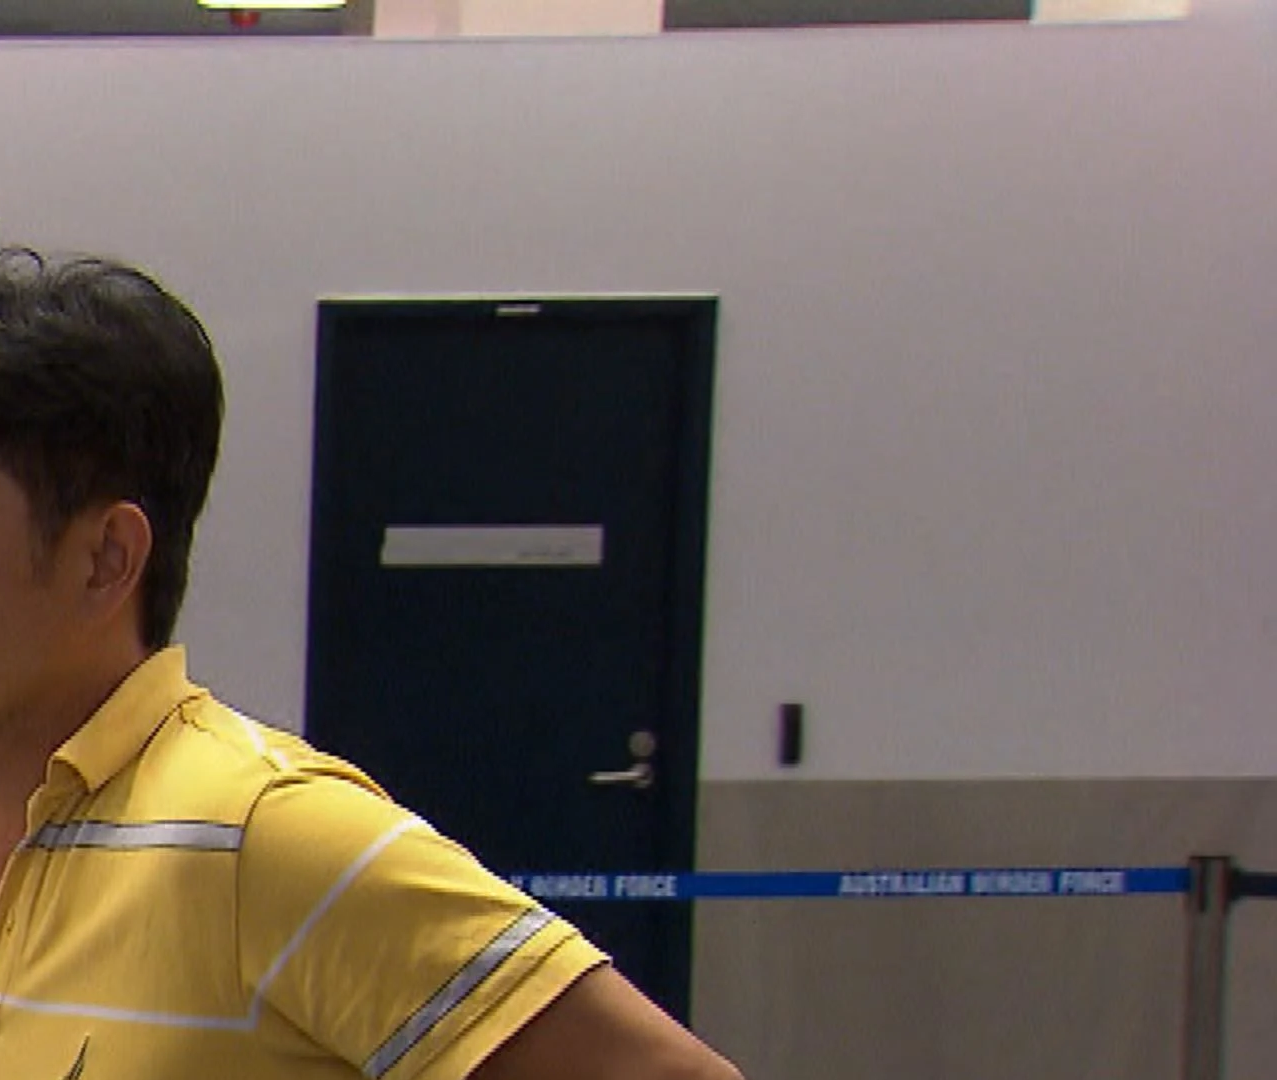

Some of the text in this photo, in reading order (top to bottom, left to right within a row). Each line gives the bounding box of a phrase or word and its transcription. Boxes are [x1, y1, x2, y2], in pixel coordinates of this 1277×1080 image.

[613, 874, 678, 897] FORCE
[840, 871, 1125, 894] AUSTRALIAN BORDER FORCE
